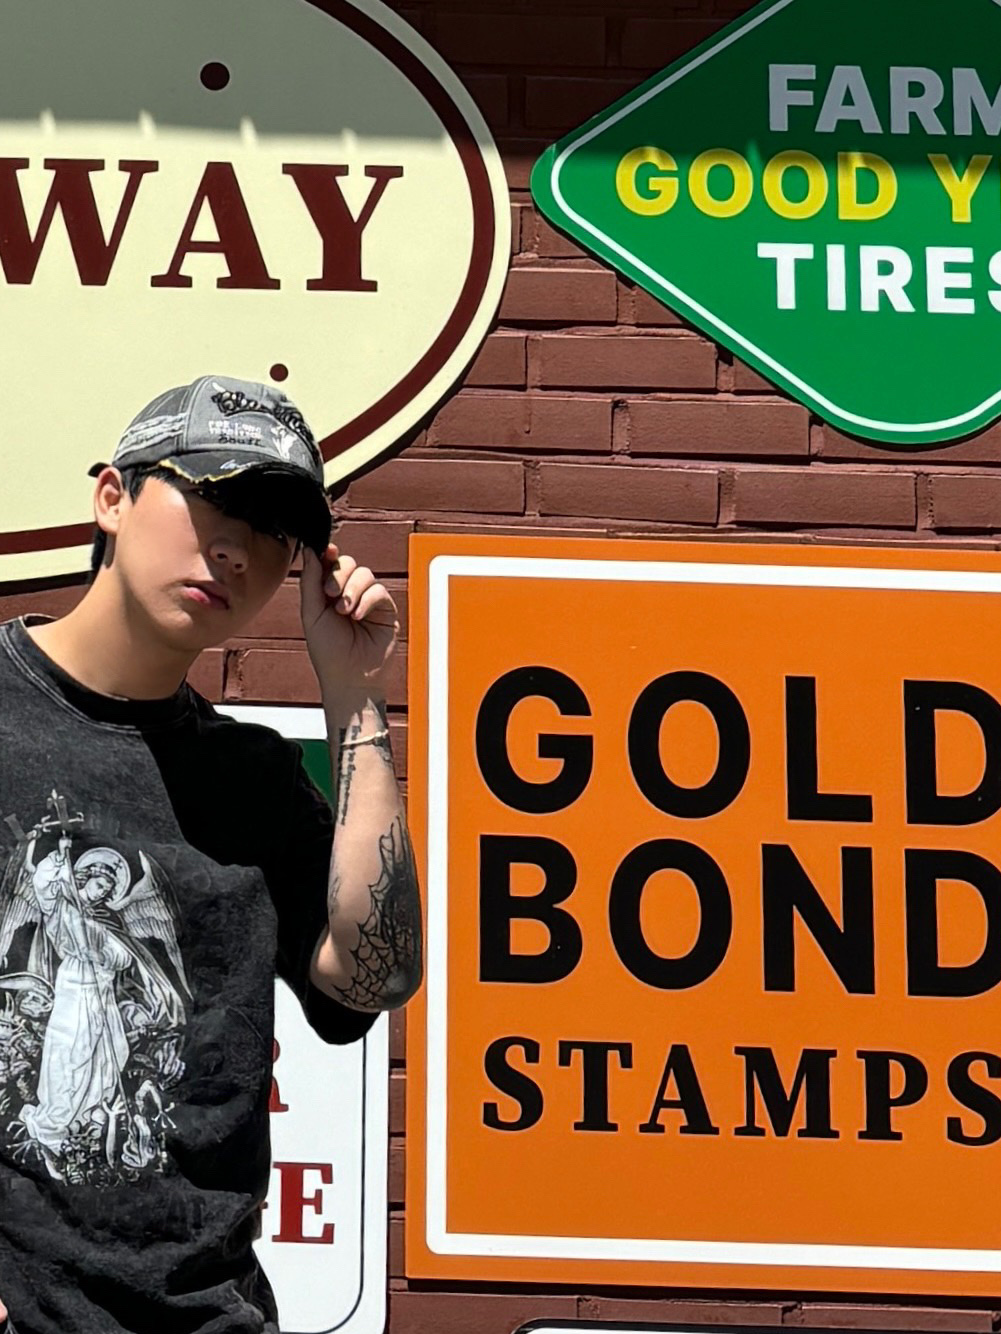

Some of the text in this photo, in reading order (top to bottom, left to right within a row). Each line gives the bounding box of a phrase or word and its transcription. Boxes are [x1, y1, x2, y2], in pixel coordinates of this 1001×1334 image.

[615, 146, 1001, 224] GOOD Y
[756, 242, 1001, 315] TIRE
[475, 665, 1001, 827] GOLD
[479, 834, 1001, 998] BOND
[482, 1036, 1001, 1147] STAMPS
